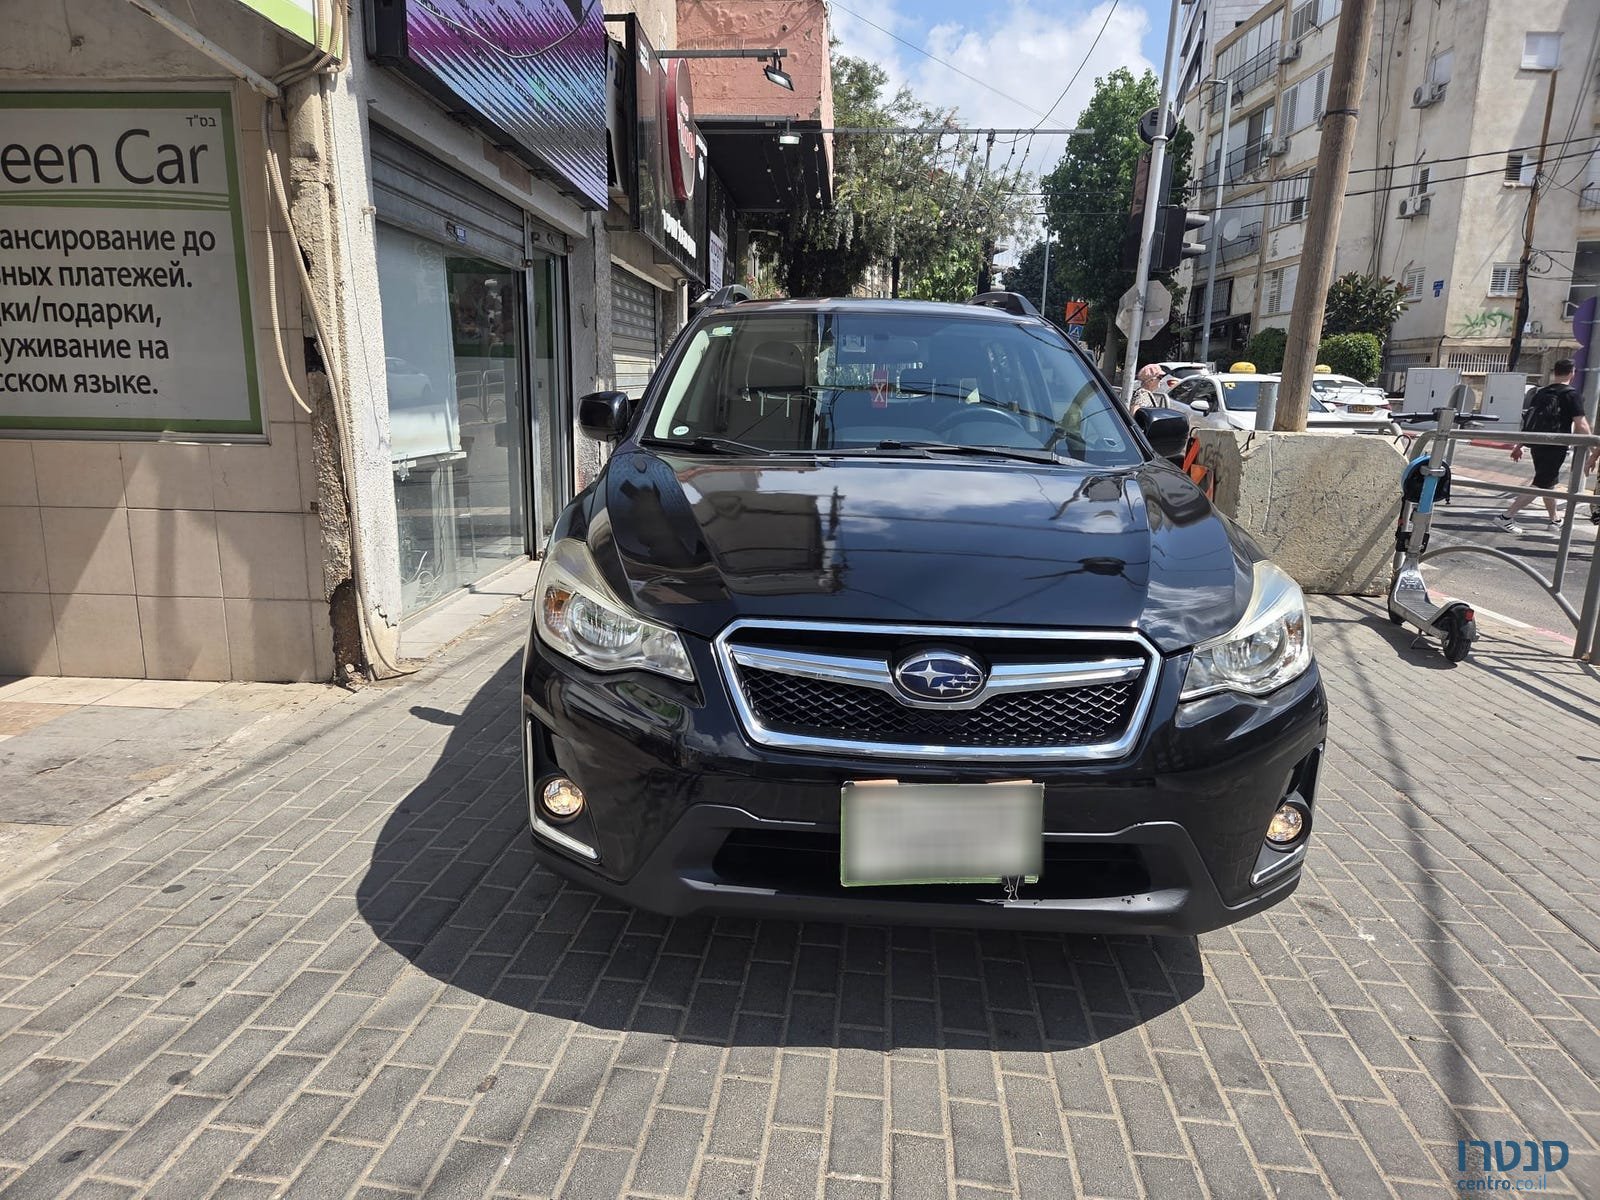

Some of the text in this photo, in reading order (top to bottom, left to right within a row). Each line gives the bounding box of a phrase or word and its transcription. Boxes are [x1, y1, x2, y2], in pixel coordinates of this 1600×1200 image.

[185, 114, 217, 128] בס"ד
[114, 128, 209, 185] Car
[0, 228, 216, 257] ансирование до
[0, 260, 193, 288] ных платежей.
[0, 295, 162, 330] ки/подарки,
[0, 337, 169, 365] уживание на
[73, 373, 159, 395] языке.
